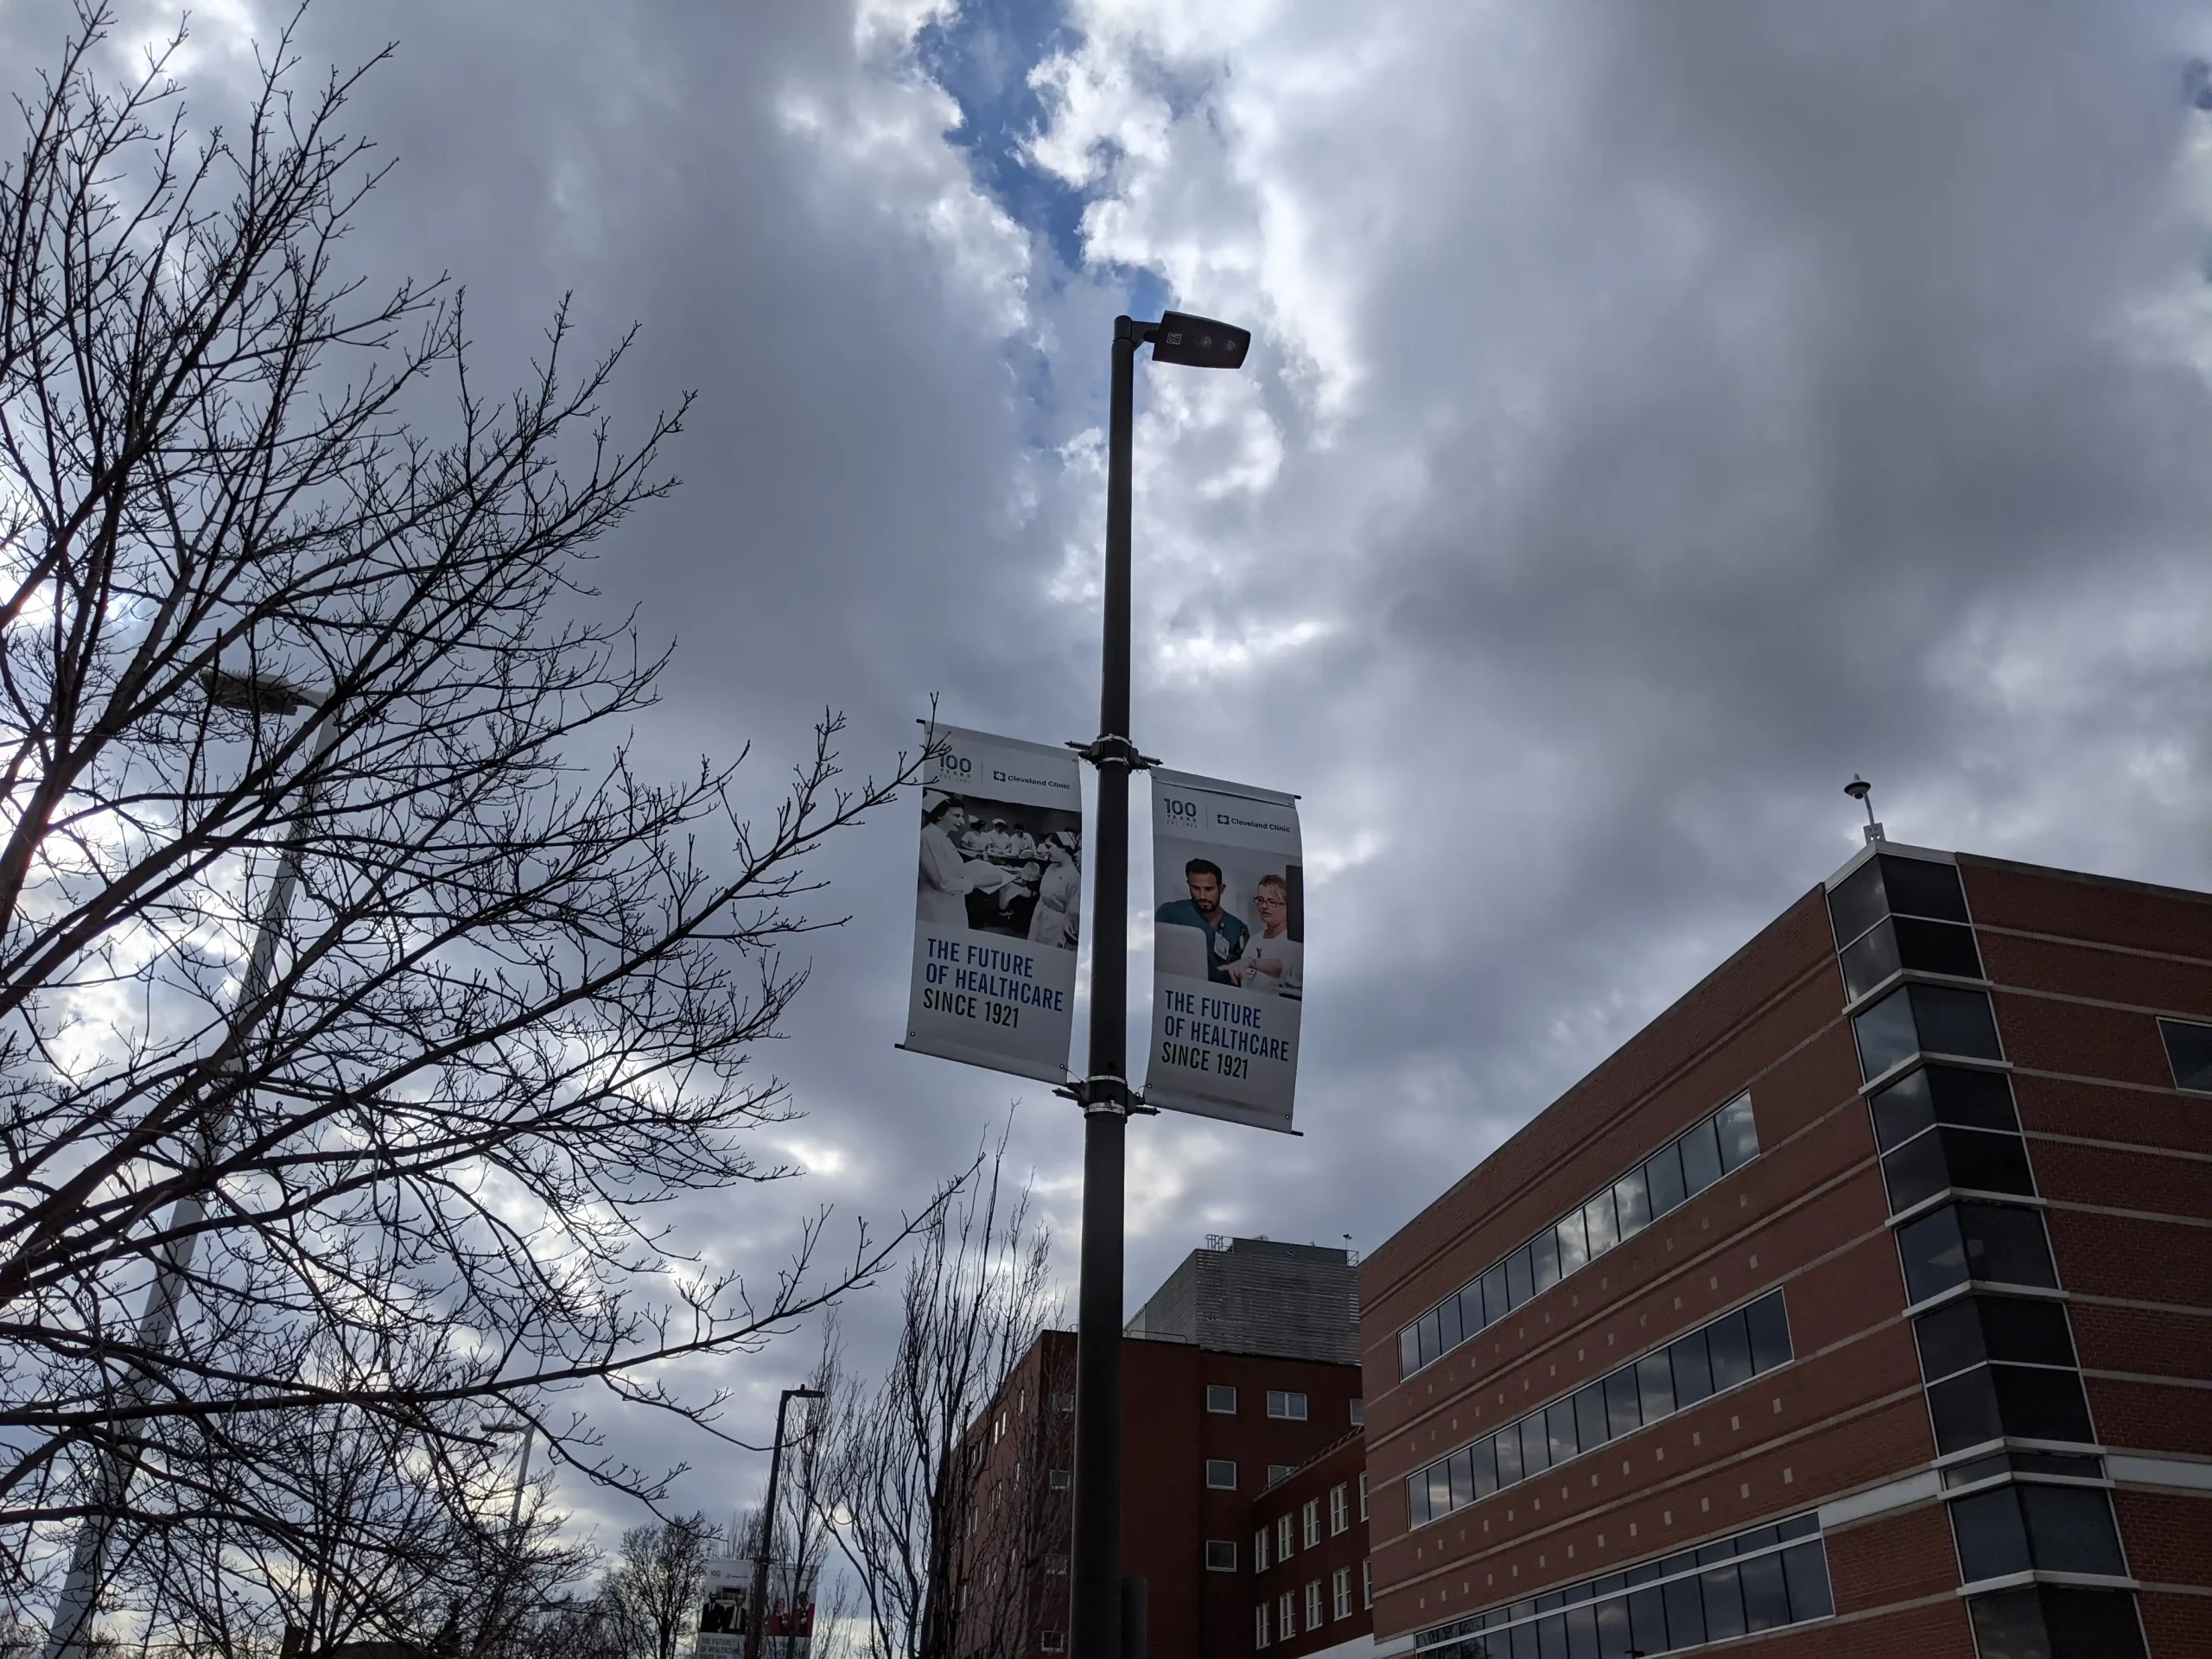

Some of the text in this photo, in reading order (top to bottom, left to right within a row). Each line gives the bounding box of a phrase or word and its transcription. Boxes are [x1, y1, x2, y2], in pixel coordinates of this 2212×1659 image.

[938, 753, 972, 772] 100
[940, 768, 971, 778] YEARS
[1007, 775, 1071, 790] Cleveland Clinic
[1163, 798, 1197, 817] 100
[1166, 814, 1197, 823] YEARS
[1231, 817, 1291, 833] Cleveland Clinic
[927, 938, 1033, 978] THE FUTURE
[925, 963, 1064, 1012] OF HEALTHCARE
[923, 988, 1019, 1028] SINCE 1921
[1165, 989, 1262, 1029] THE FUTURE
[1164, 1015, 1289, 1062] OF HEALTHCARE
[1161, 1041, 1249, 1079] SINCE 1921
